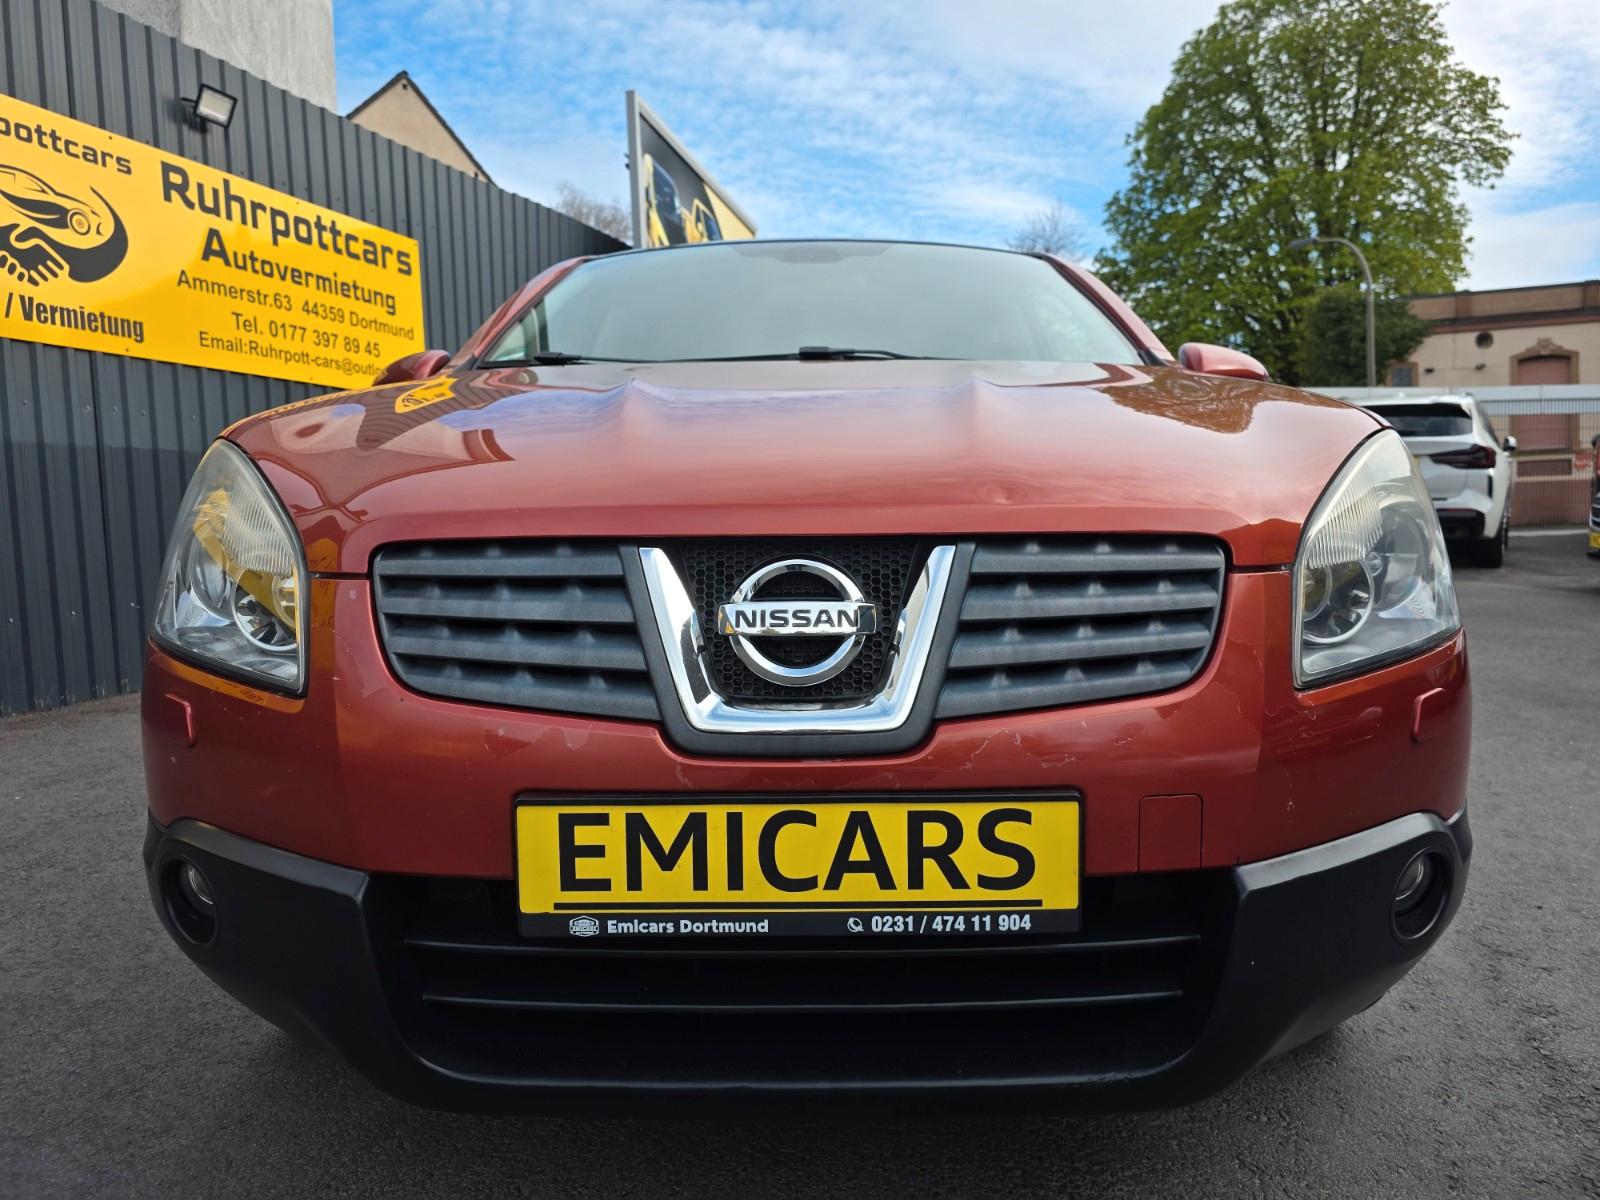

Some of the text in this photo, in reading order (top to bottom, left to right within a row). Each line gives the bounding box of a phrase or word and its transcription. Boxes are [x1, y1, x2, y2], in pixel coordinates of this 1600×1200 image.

[160, 160, 412, 276] Ruhrpottcars
[201, 227, 396, 316] Autovermietung
[4, 292, 145, 344] / Vermietung
[177, 269, 415, 341] Ammerstr.63 44359 Dortmund
[231, 311, 381, 358] Tel. 0177 397 89 45
[735, 609, 859, 629] NISSAN
[557, 808, 1036, 893] EMICARS
[607, 919, 675, 934] Emicars
[680, 919, 769, 933] Dortmund
[871, 915, 914, 933] 0231
[919, 915, 928, 934] /
[932, 915, 966, 932] 474
[971, 915, 992, 932] 11
[998, 914, 1032, 932] 904
